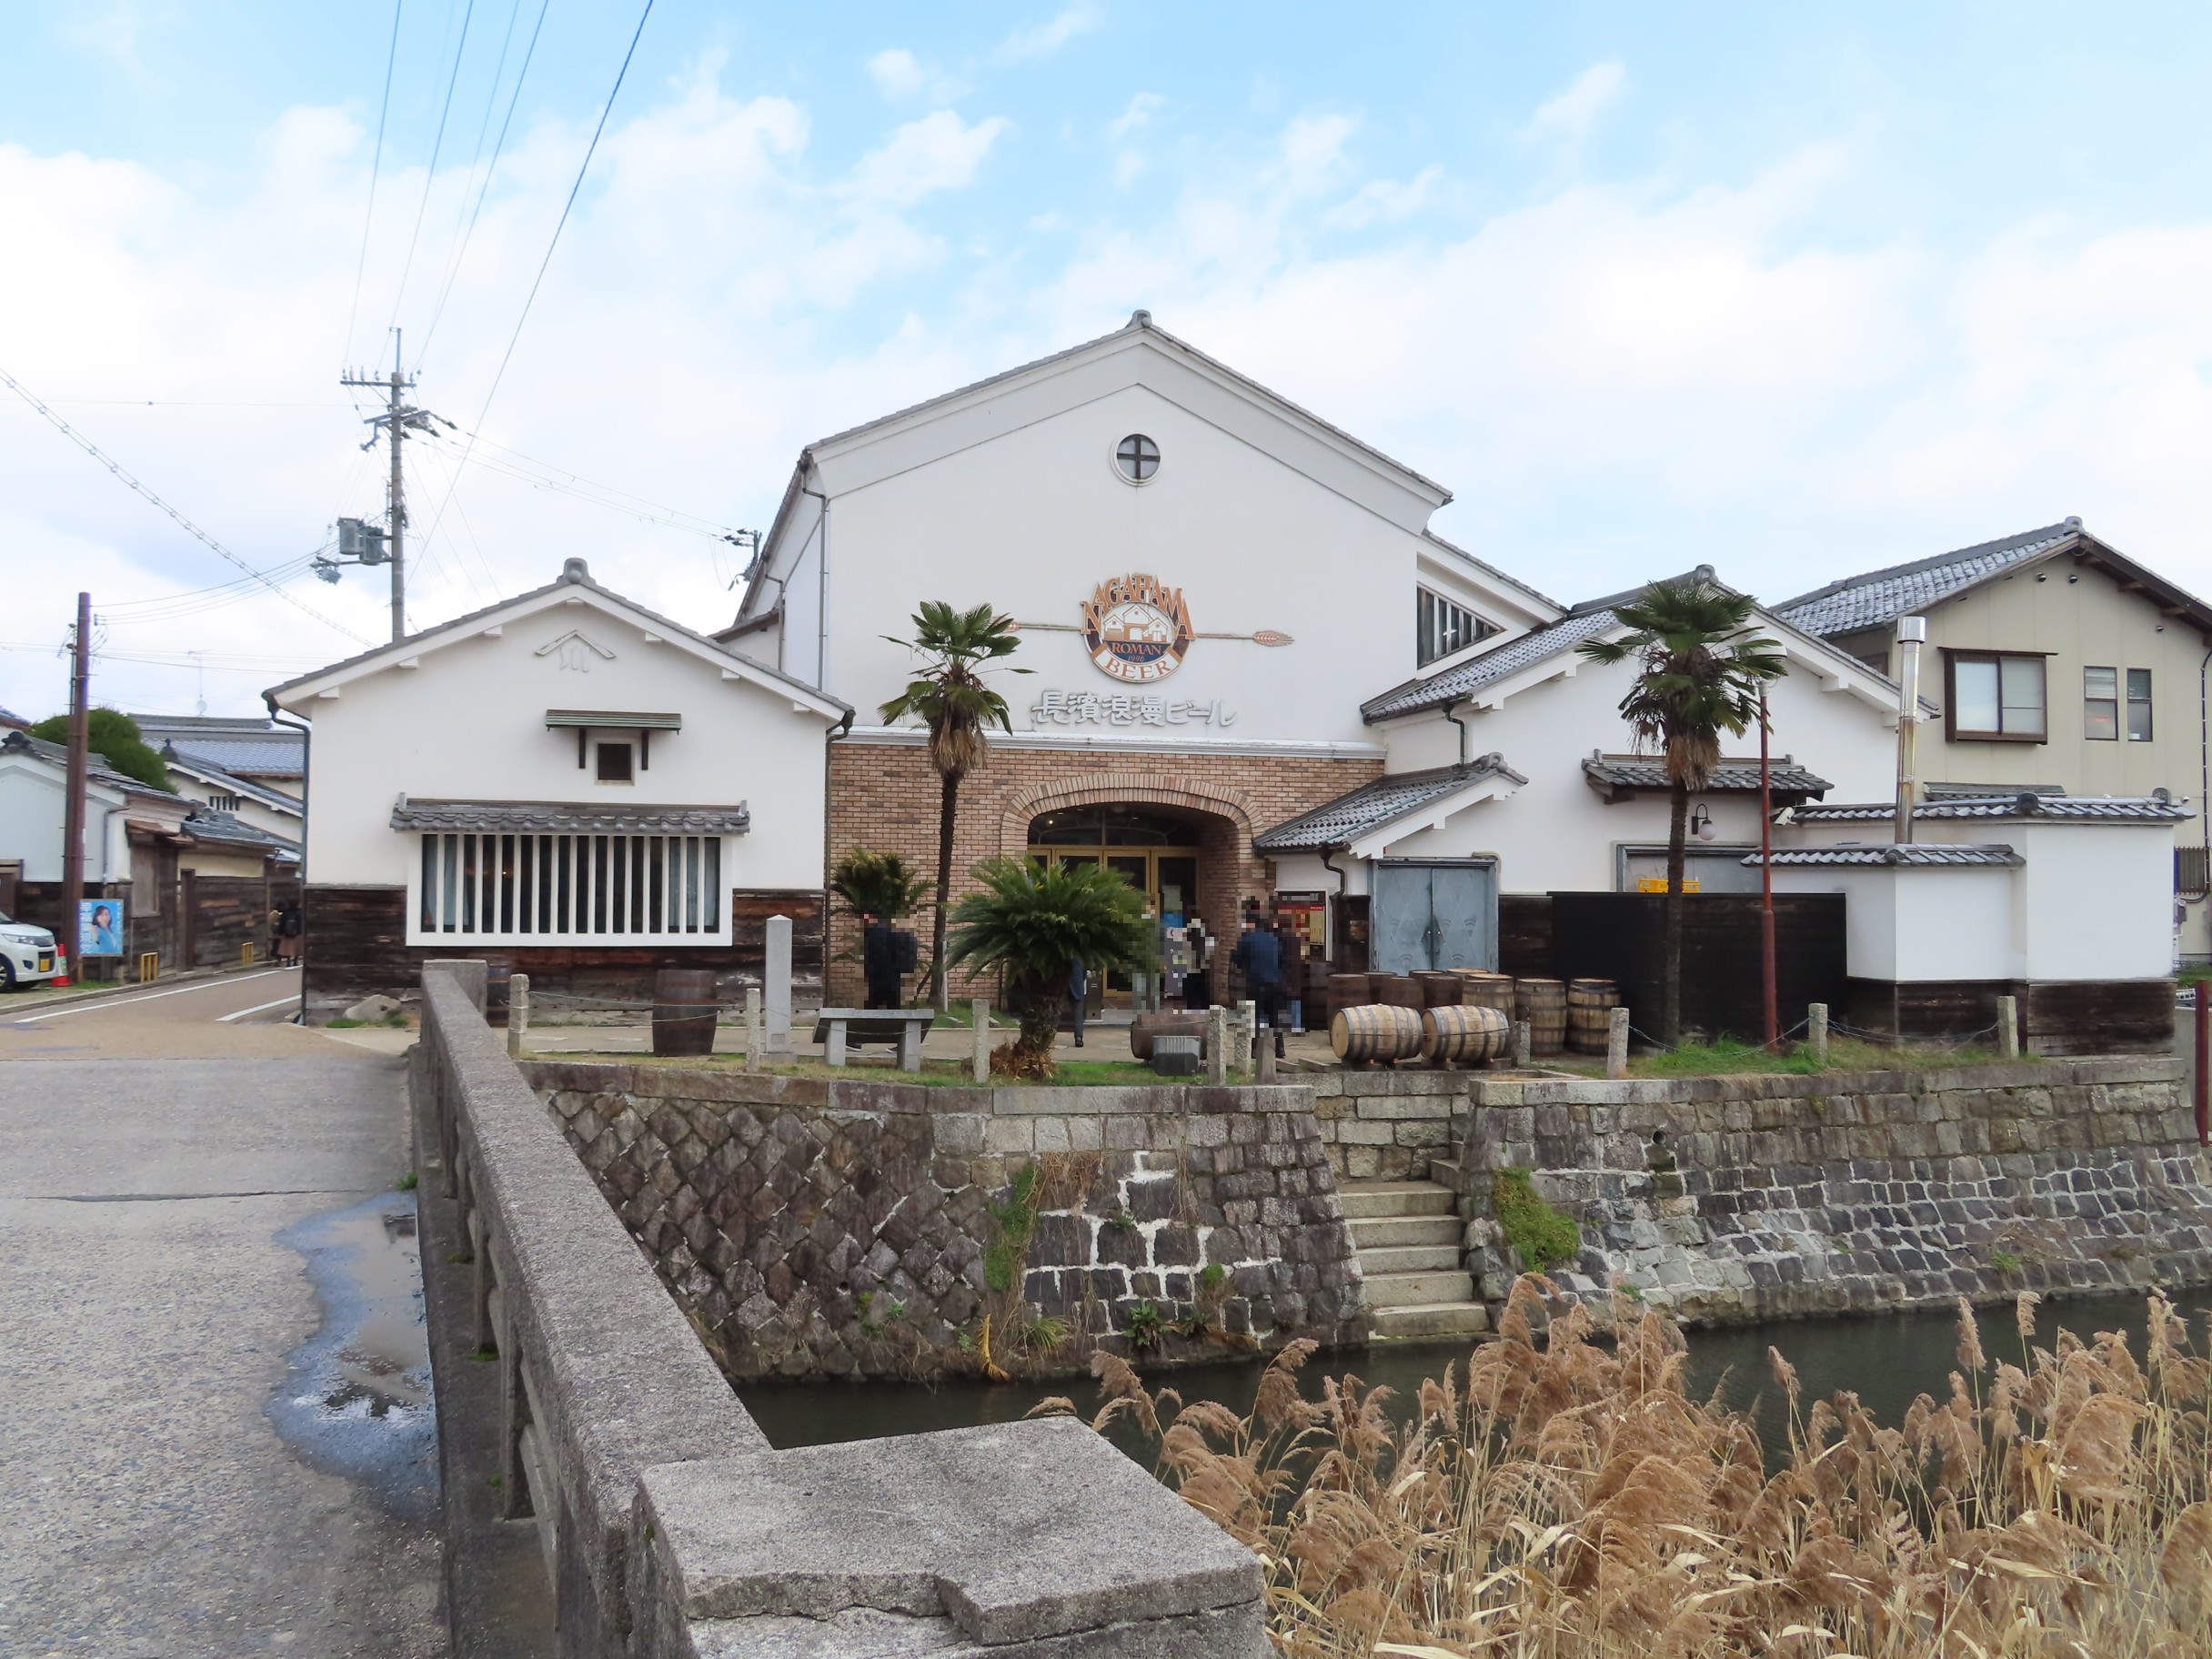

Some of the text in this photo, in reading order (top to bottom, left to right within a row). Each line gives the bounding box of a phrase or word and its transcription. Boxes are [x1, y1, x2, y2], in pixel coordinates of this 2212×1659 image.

[1081, 573, 1195, 640] NAGAHAMA
[1111, 642, 1162, 656] ROMAN
[1128, 654, 1145, 663] 1996
[1105, 657, 1172, 679] BEER
